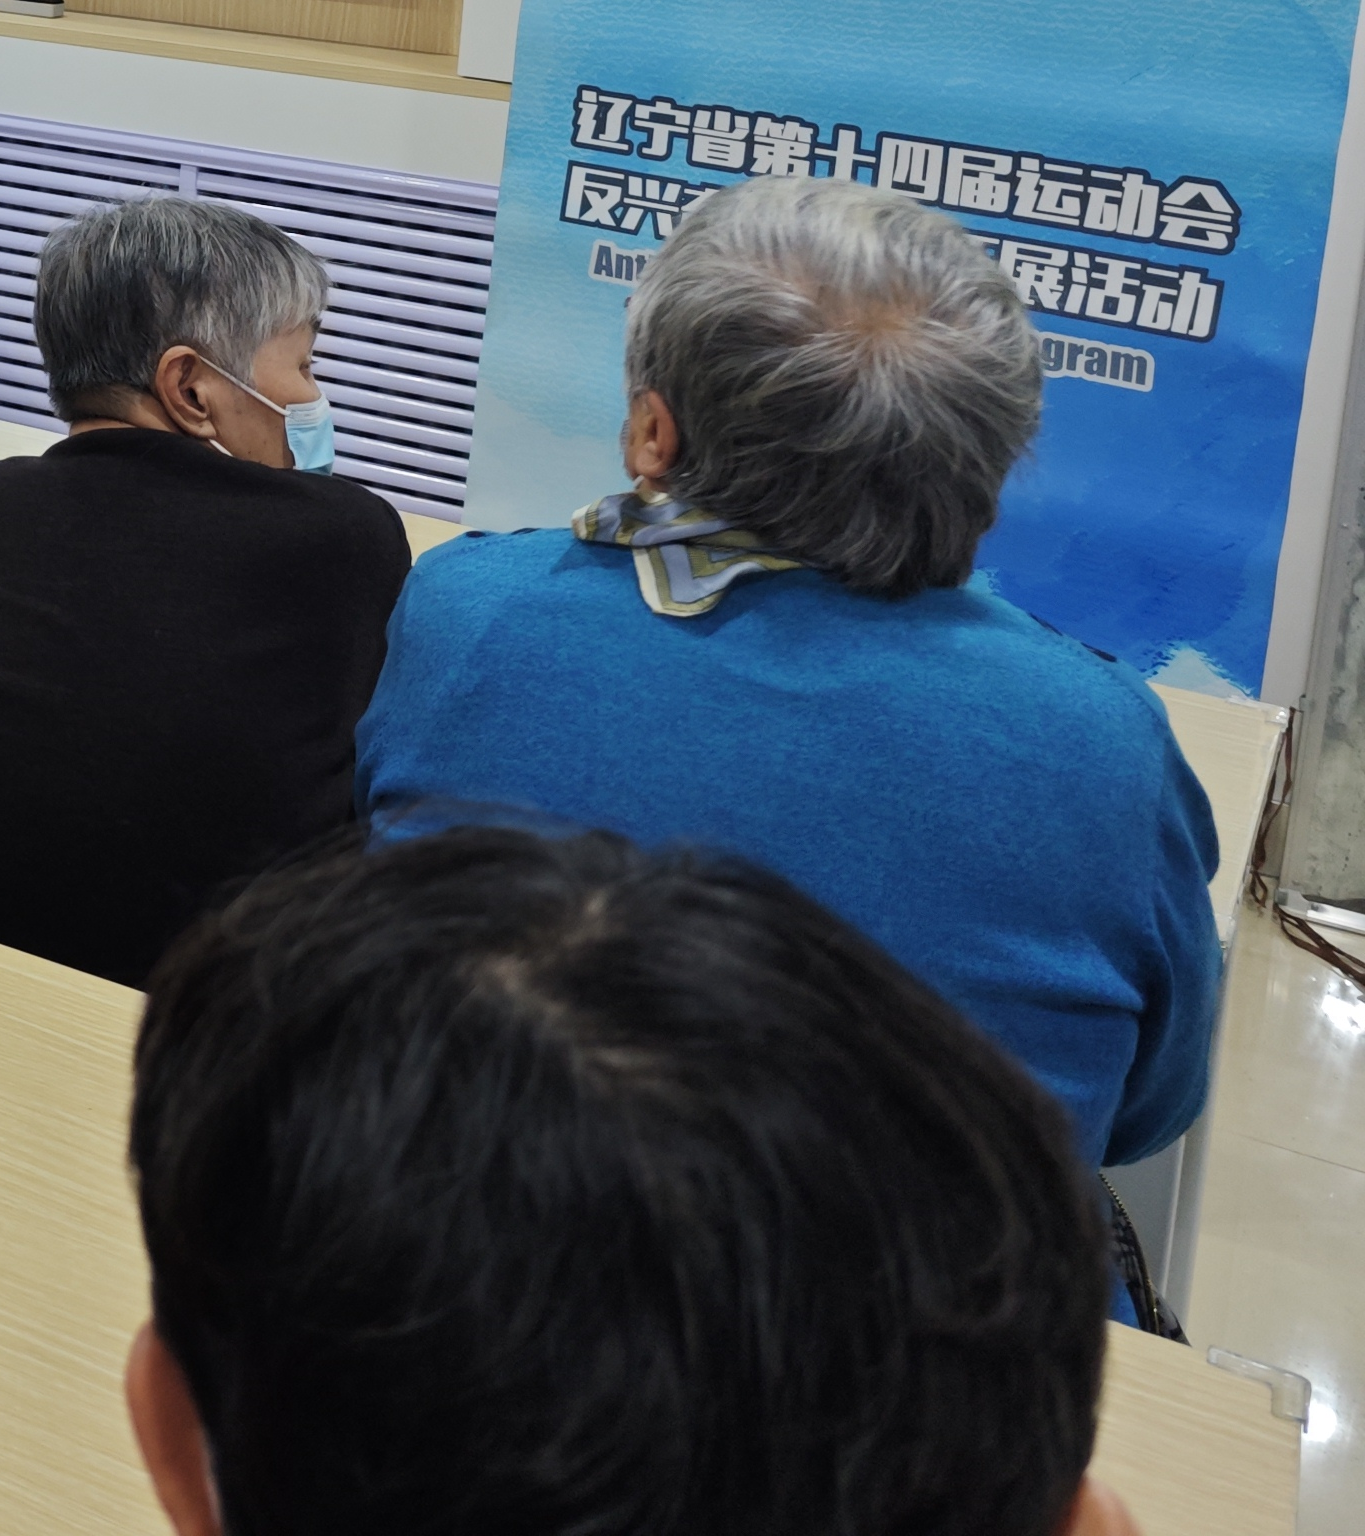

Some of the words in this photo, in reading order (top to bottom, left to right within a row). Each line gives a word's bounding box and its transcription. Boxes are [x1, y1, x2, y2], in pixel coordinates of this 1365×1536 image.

[574, 89, 1240, 251] 辽宁省第十四届运动会
[594, 245, 655, 281] Ant
[1041, 337, 1148, 386] gram
[966, 233, 1218, 338] 展活动
